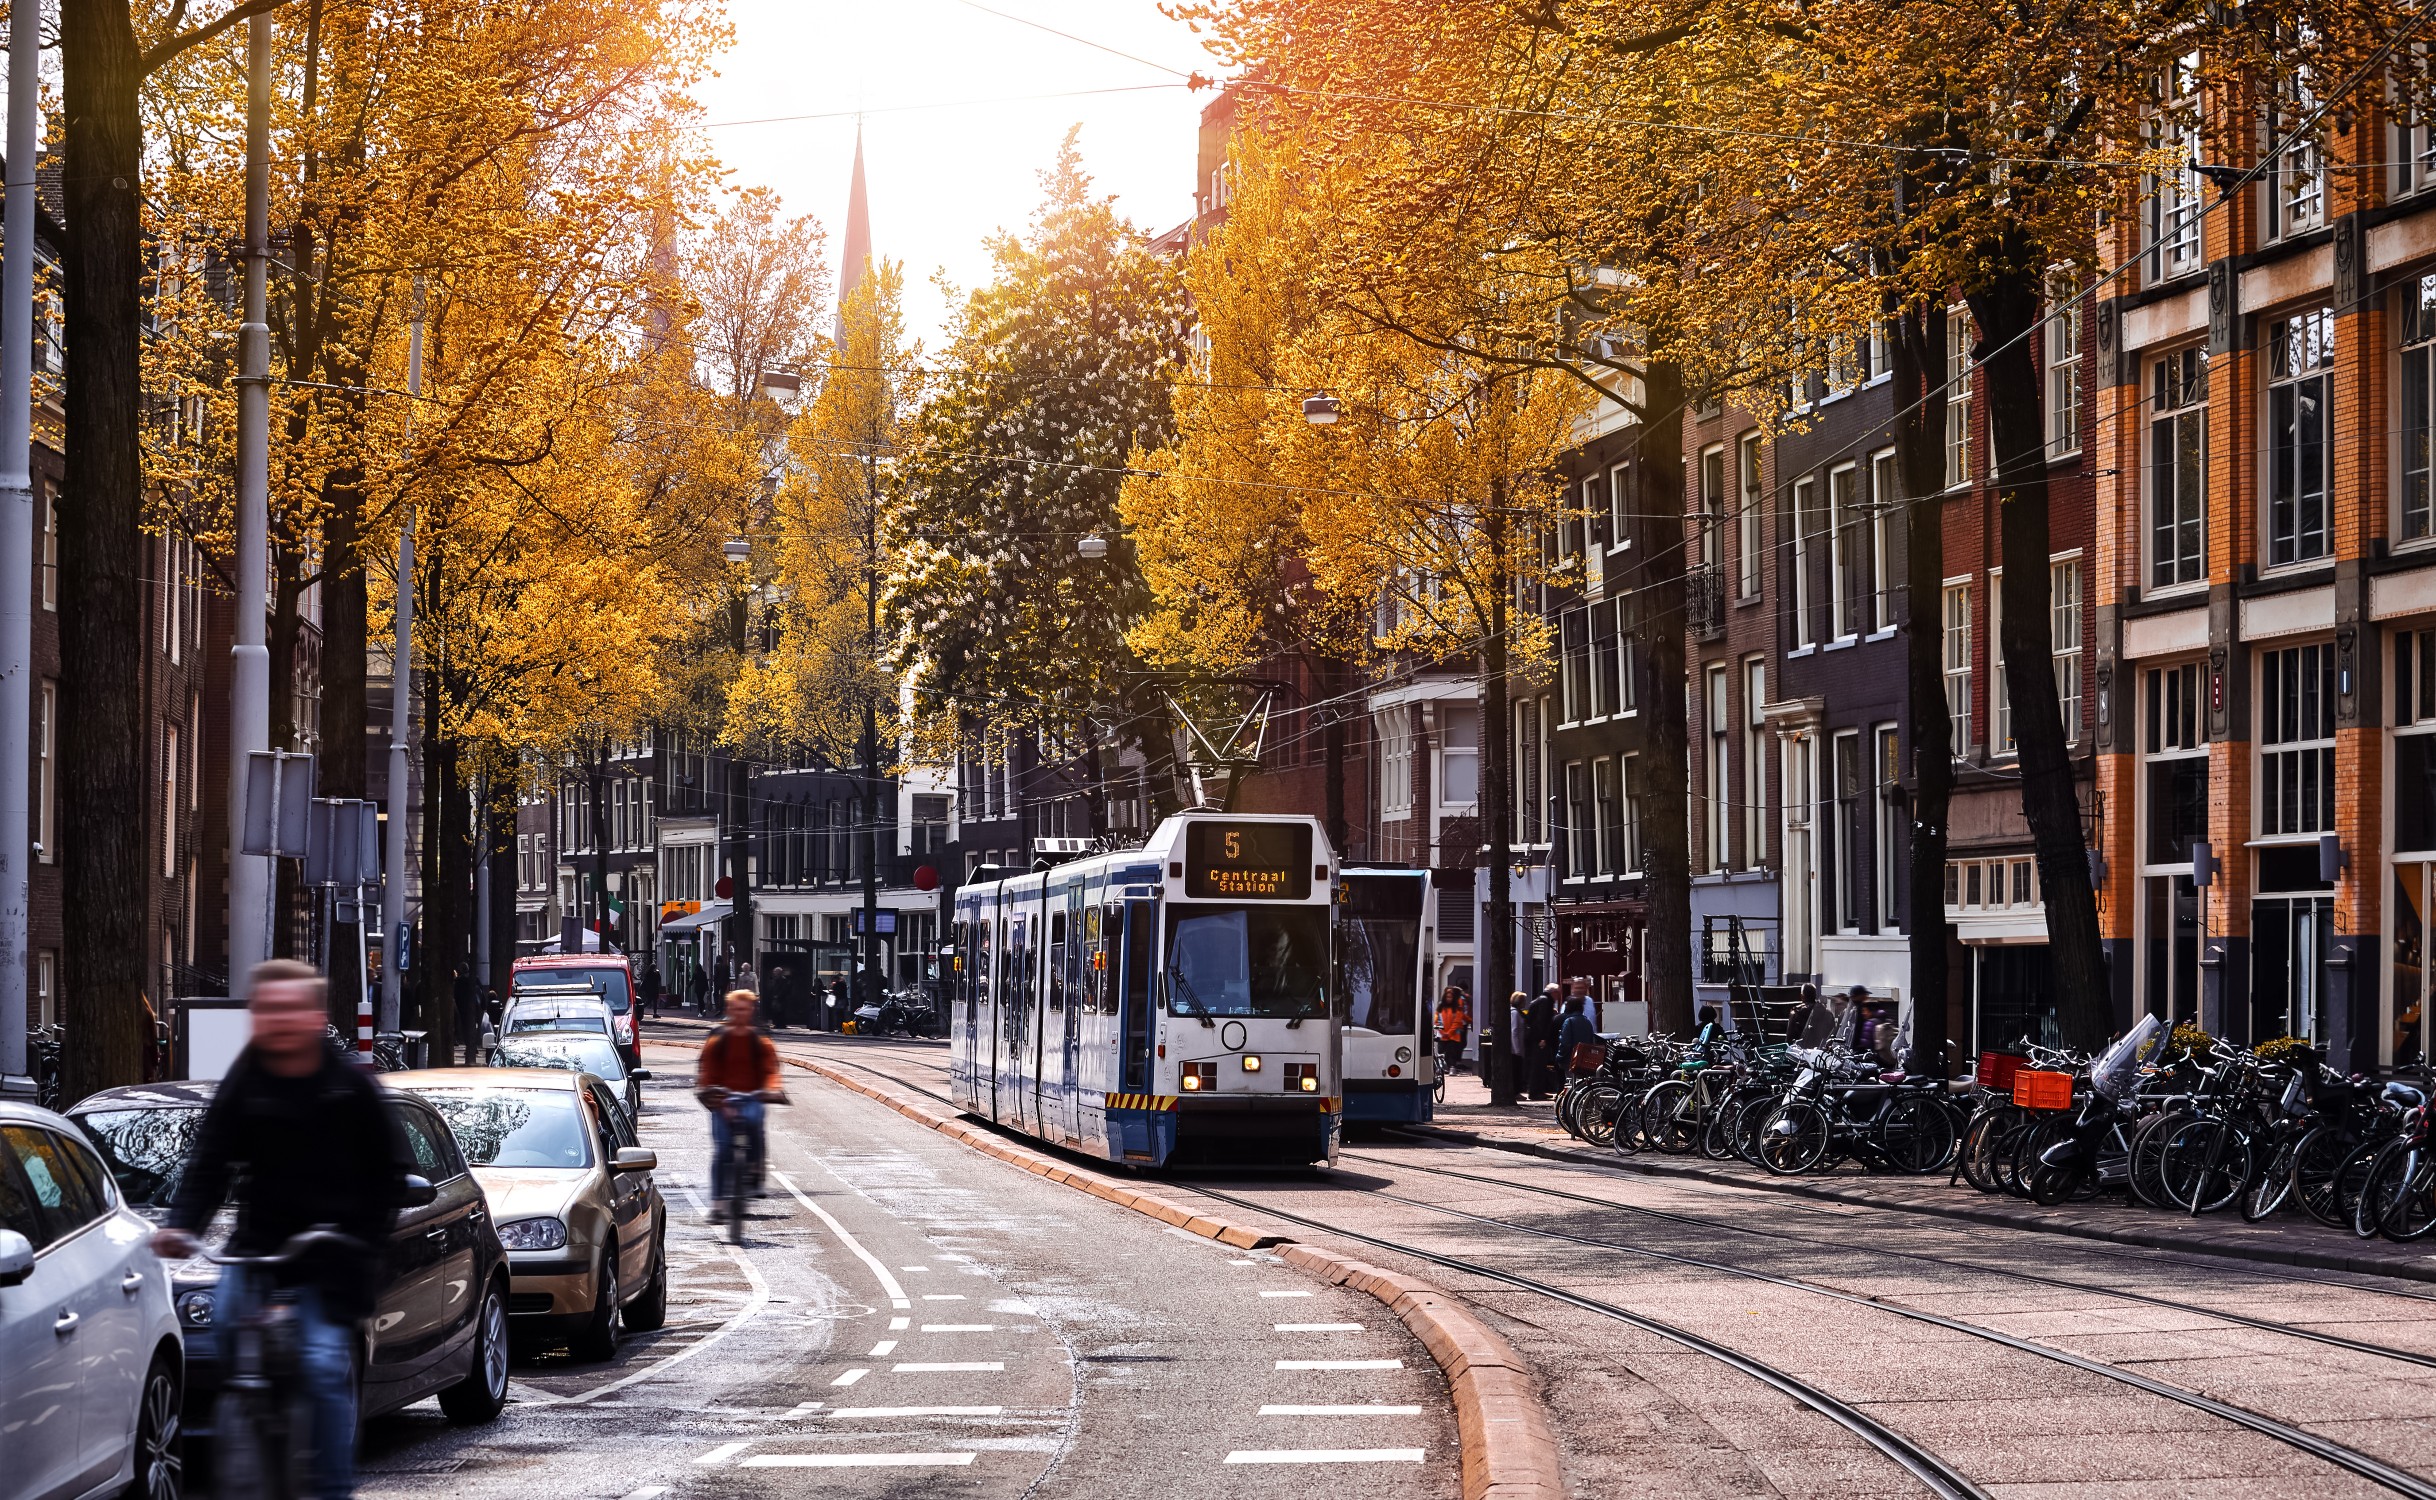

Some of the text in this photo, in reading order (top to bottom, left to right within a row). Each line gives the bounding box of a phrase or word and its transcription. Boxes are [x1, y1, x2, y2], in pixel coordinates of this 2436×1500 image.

[1225, 831, 1240, 859] 5
[1210, 869, 1285, 881] Centraal
[1219, 881, 1276, 893] Station
[401, 926, 409, 950] P
